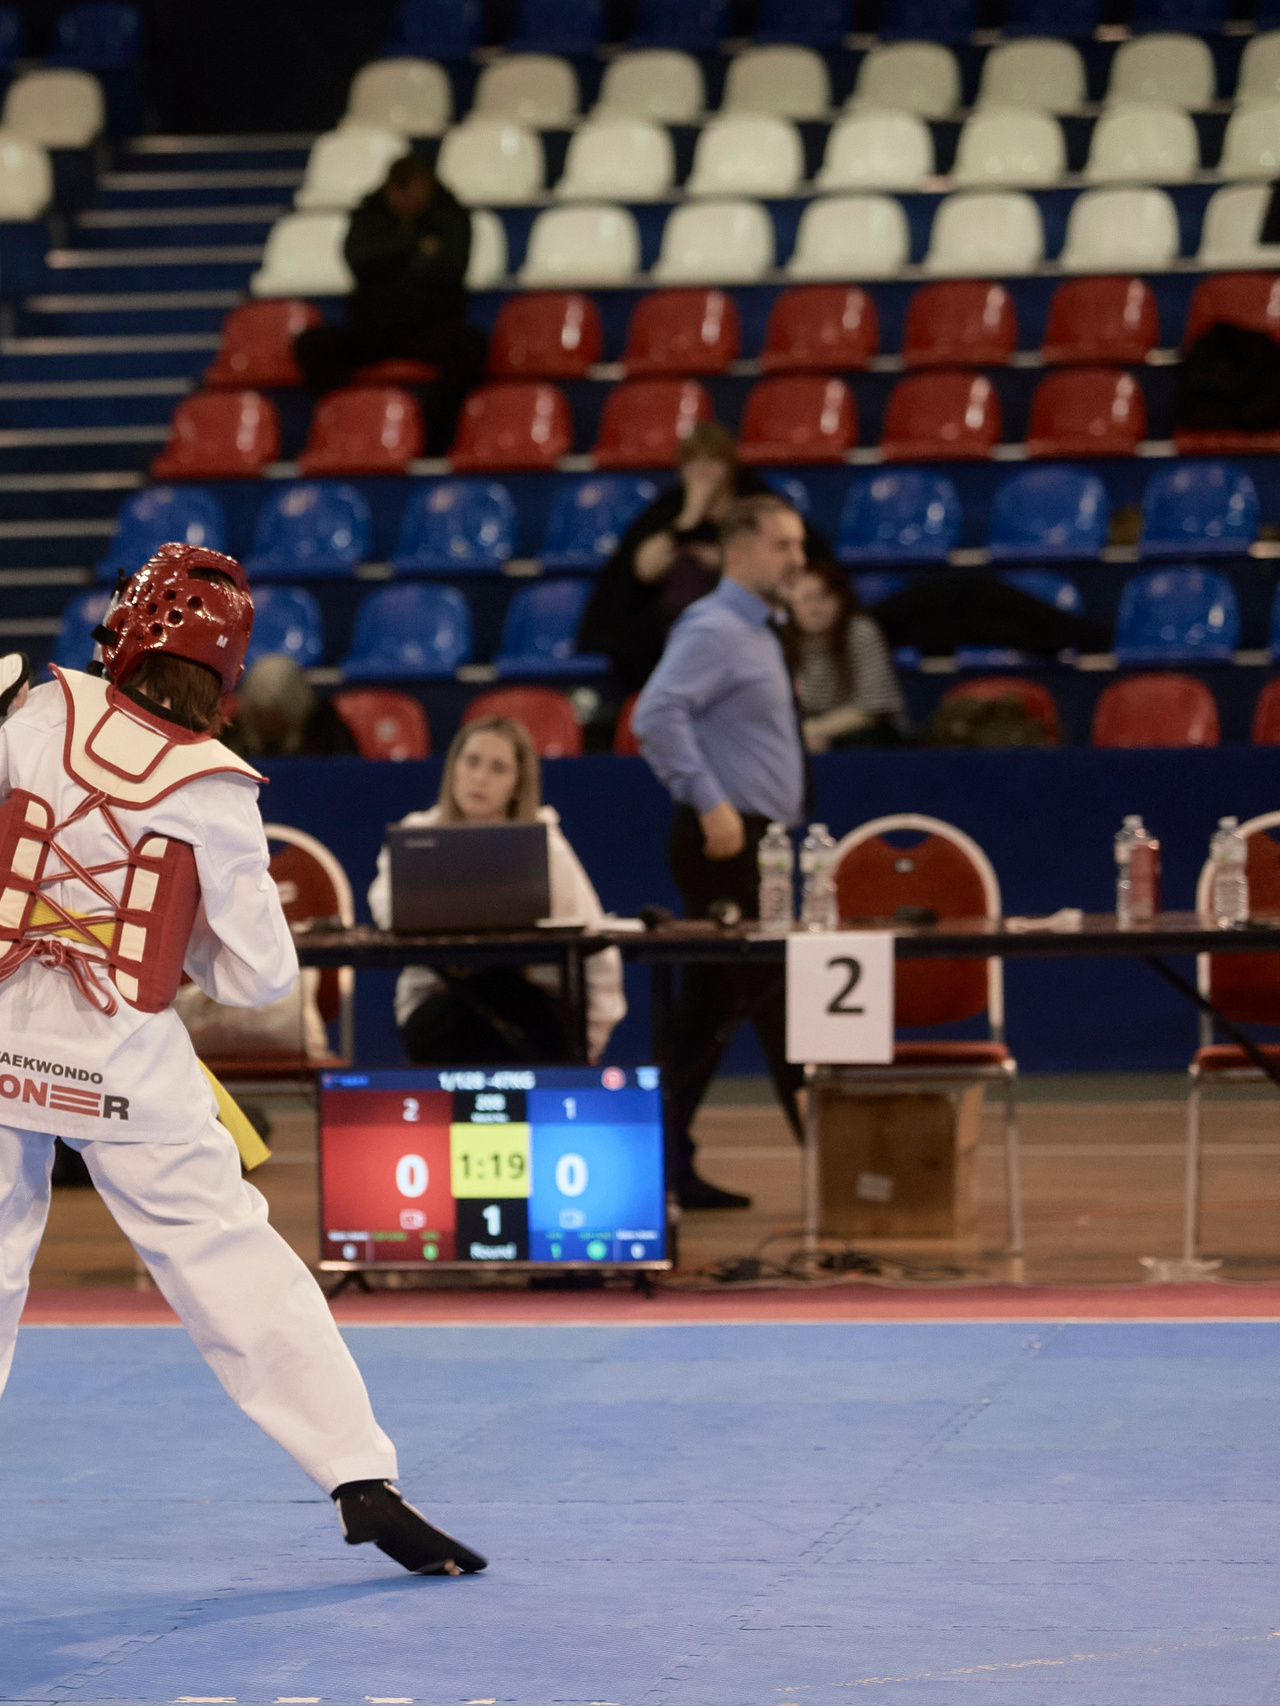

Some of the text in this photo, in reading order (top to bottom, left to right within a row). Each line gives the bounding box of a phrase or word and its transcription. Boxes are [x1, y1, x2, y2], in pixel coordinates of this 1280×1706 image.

[826, 957, 866, 1015] 2
[403, 1097, 420, 1122] 2
[563, 1097, 577, 1120] 1
[395, 1154, 429, 1198] 0
[460, 1153, 525, 1179] 1:19
[555, 1154, 588, 1198] 0
[482, 1204, 502, 1236] 1
[470, 1242, 517, 1261] Round
